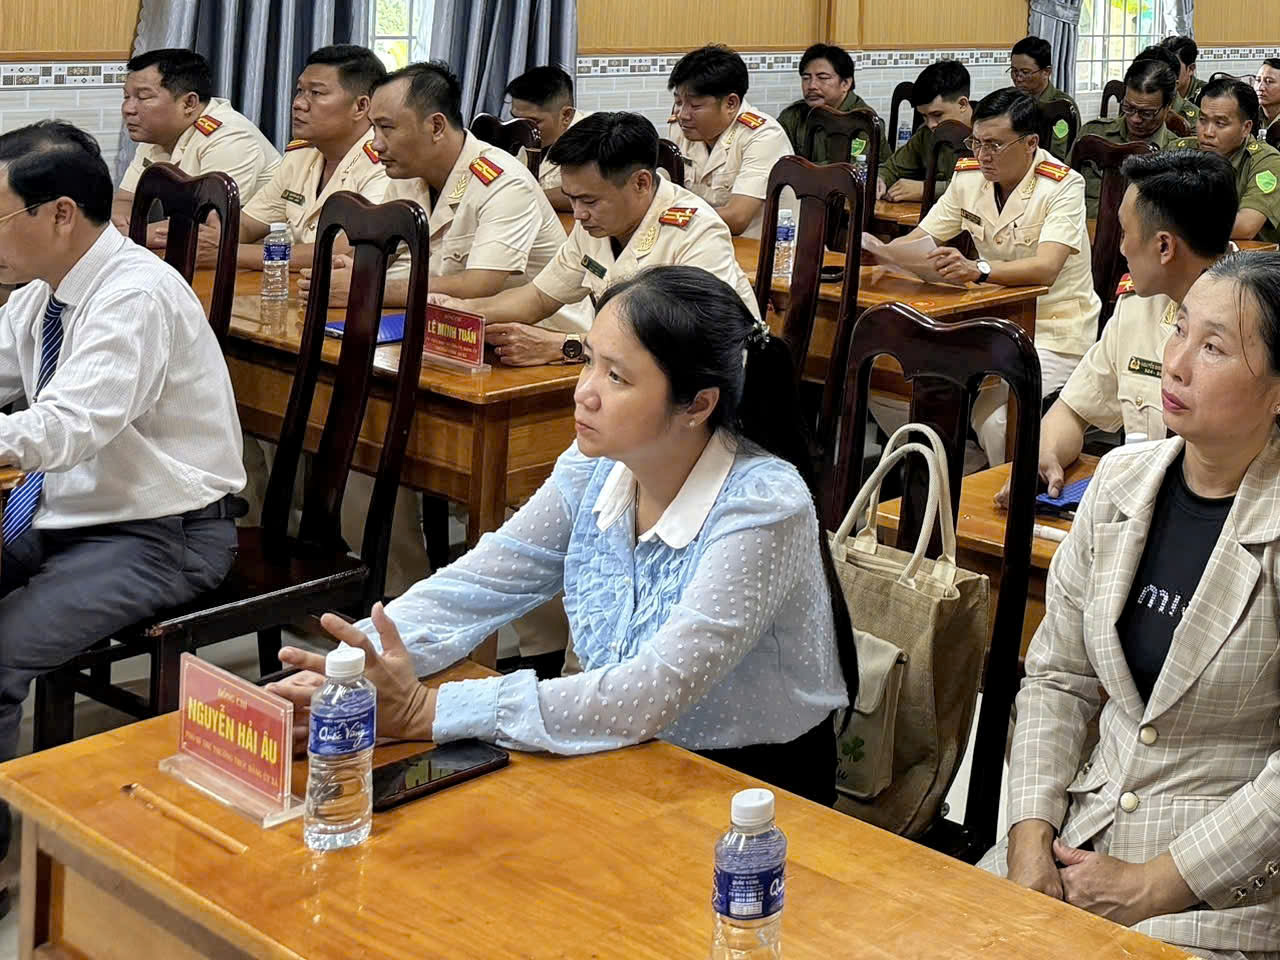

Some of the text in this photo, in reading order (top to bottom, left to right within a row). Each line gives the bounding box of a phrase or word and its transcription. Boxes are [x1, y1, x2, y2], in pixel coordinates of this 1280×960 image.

[187, 696, 235, 743] NGUYỄN
[237, 720, 259, 756] HẢI
[260, 730, 278, 765] ÂU
